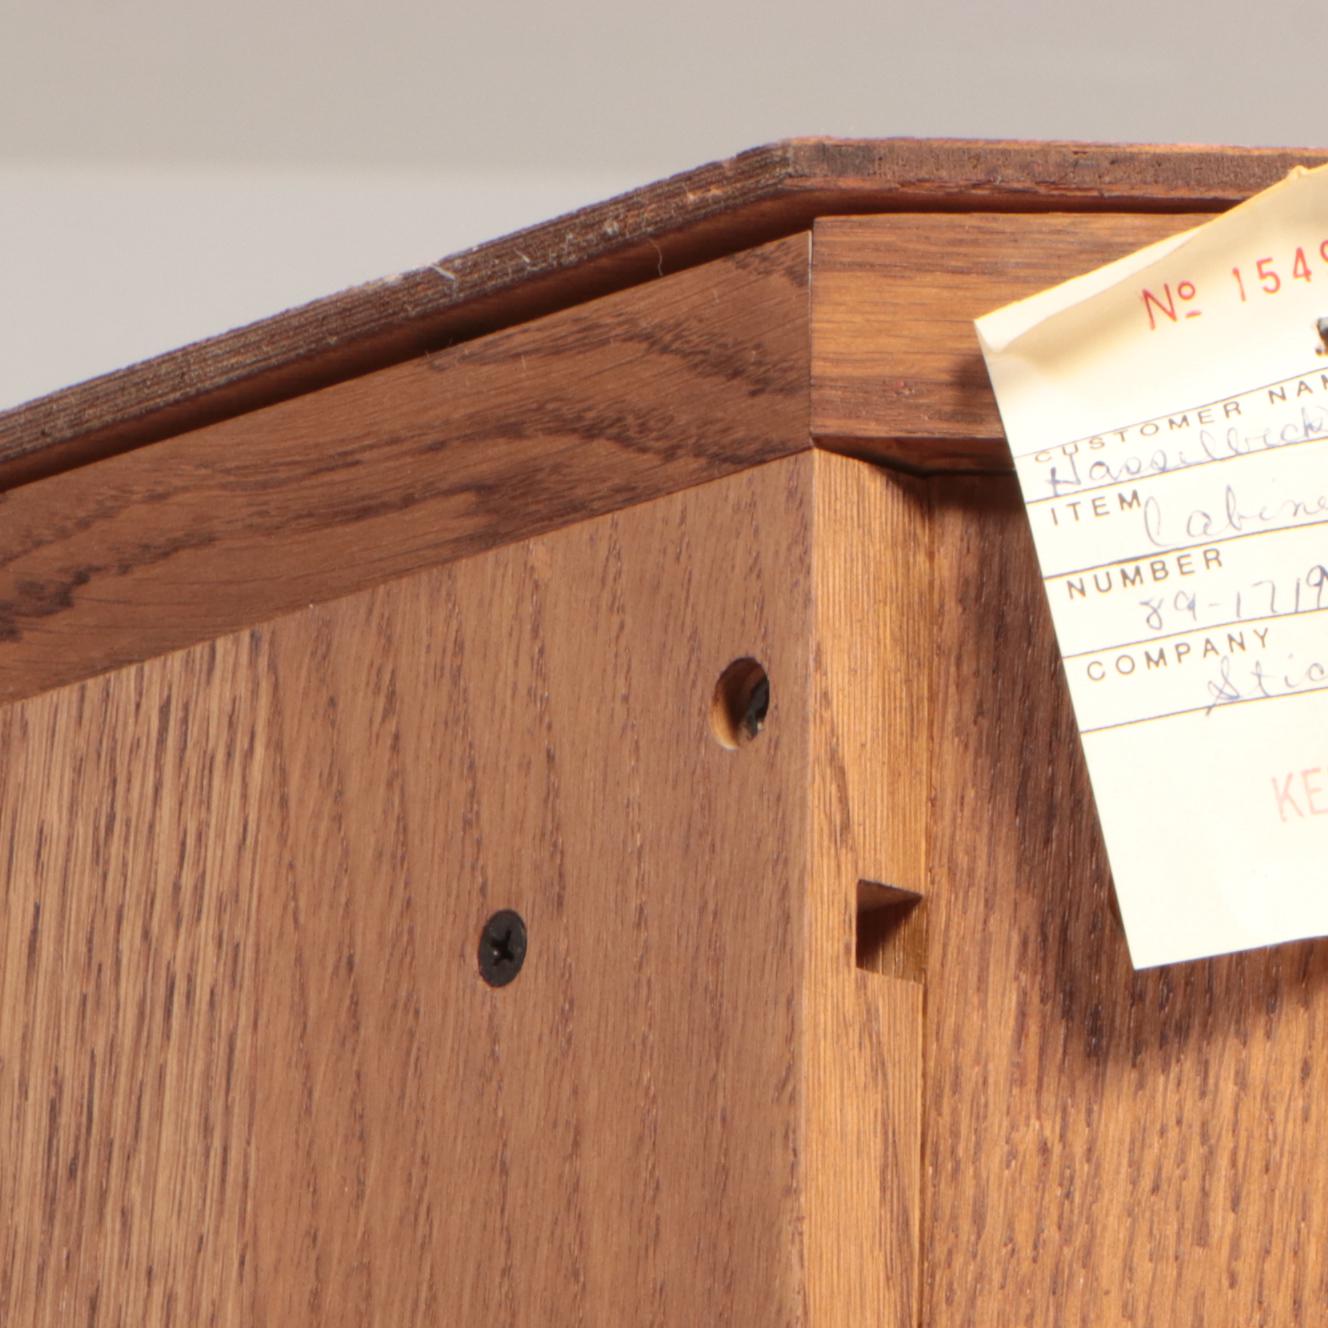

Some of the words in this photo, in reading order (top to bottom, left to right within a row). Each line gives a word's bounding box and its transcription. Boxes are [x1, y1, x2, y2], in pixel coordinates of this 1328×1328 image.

[1034, 401, 1243, 464] CUSTOMER
[1050, 489, 1142, 527] ITEM
[1066, 547, 1225, 601] NUMBER
[1085, 627, 1272, 682] COMPANY
